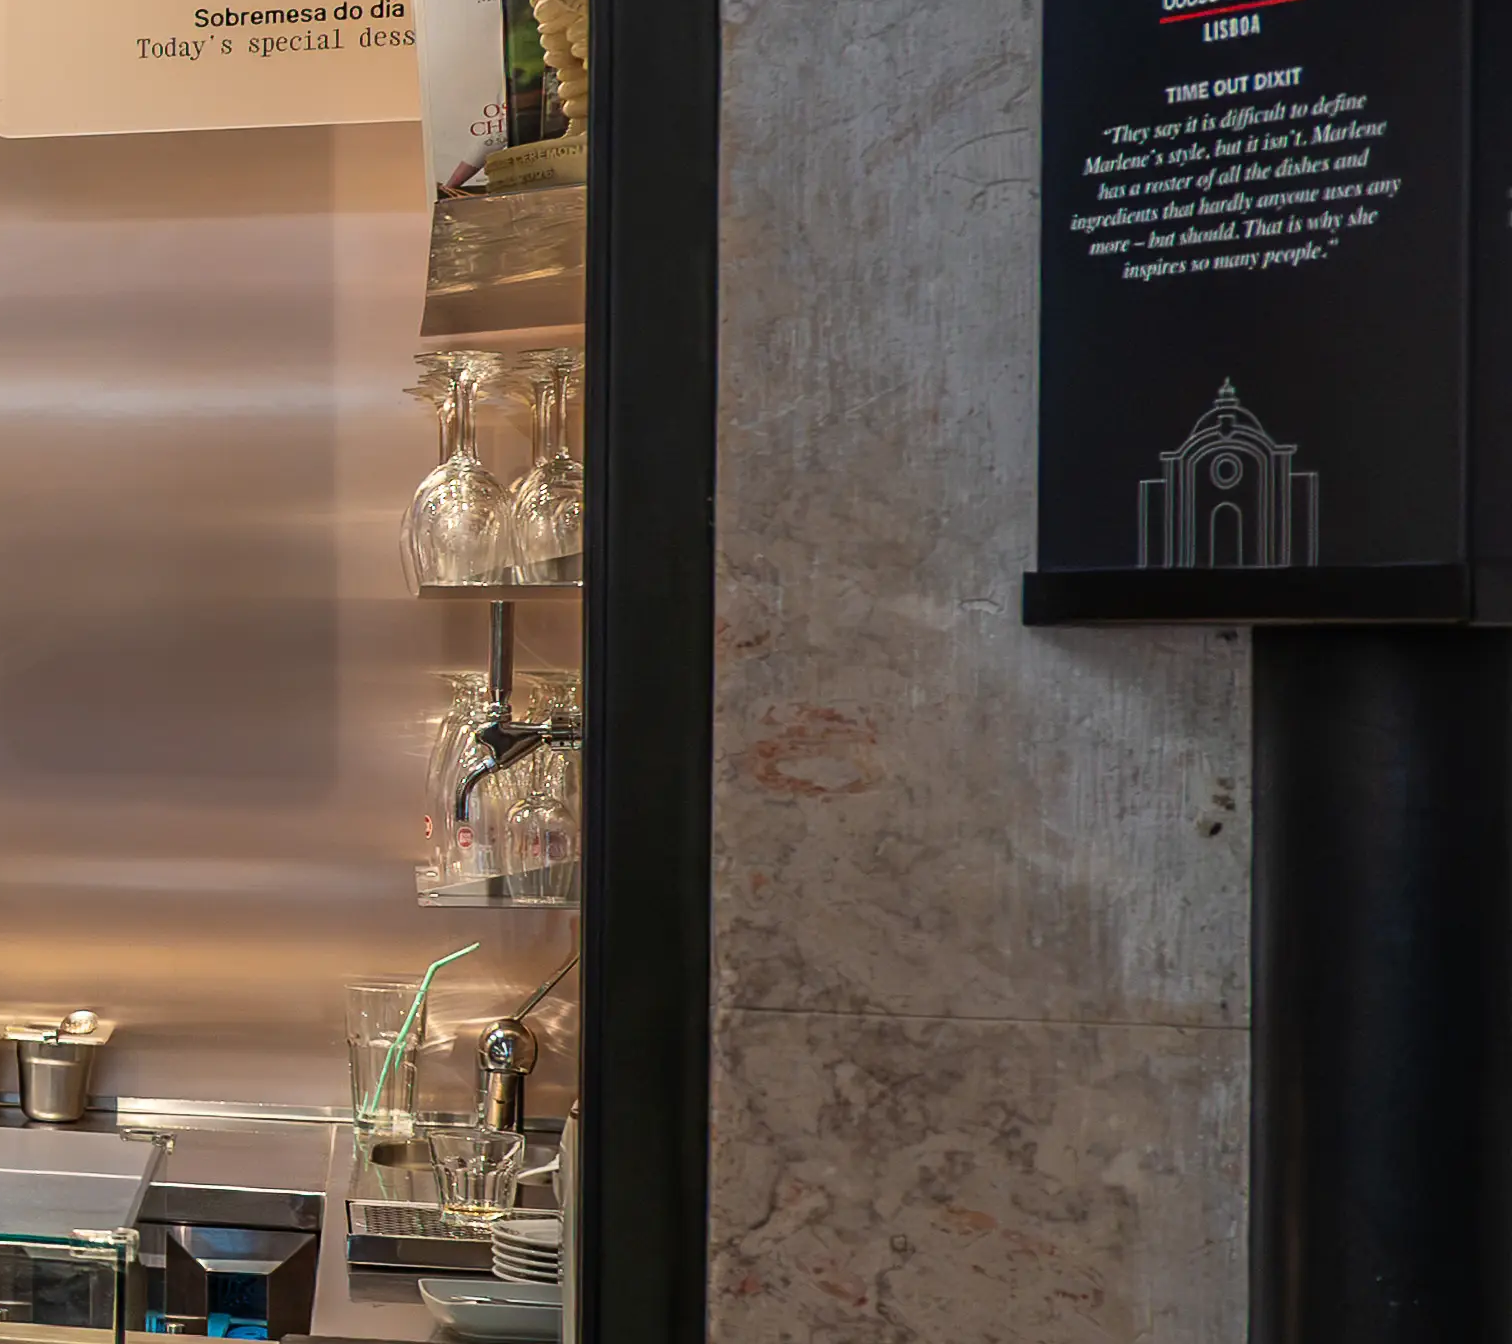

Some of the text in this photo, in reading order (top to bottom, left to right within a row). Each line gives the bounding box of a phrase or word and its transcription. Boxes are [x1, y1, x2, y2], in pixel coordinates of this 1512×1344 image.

[1203, 13, 1261, 42] LISBOA
[1165, 67, 1303, 104] TIME OUT DIXIT
